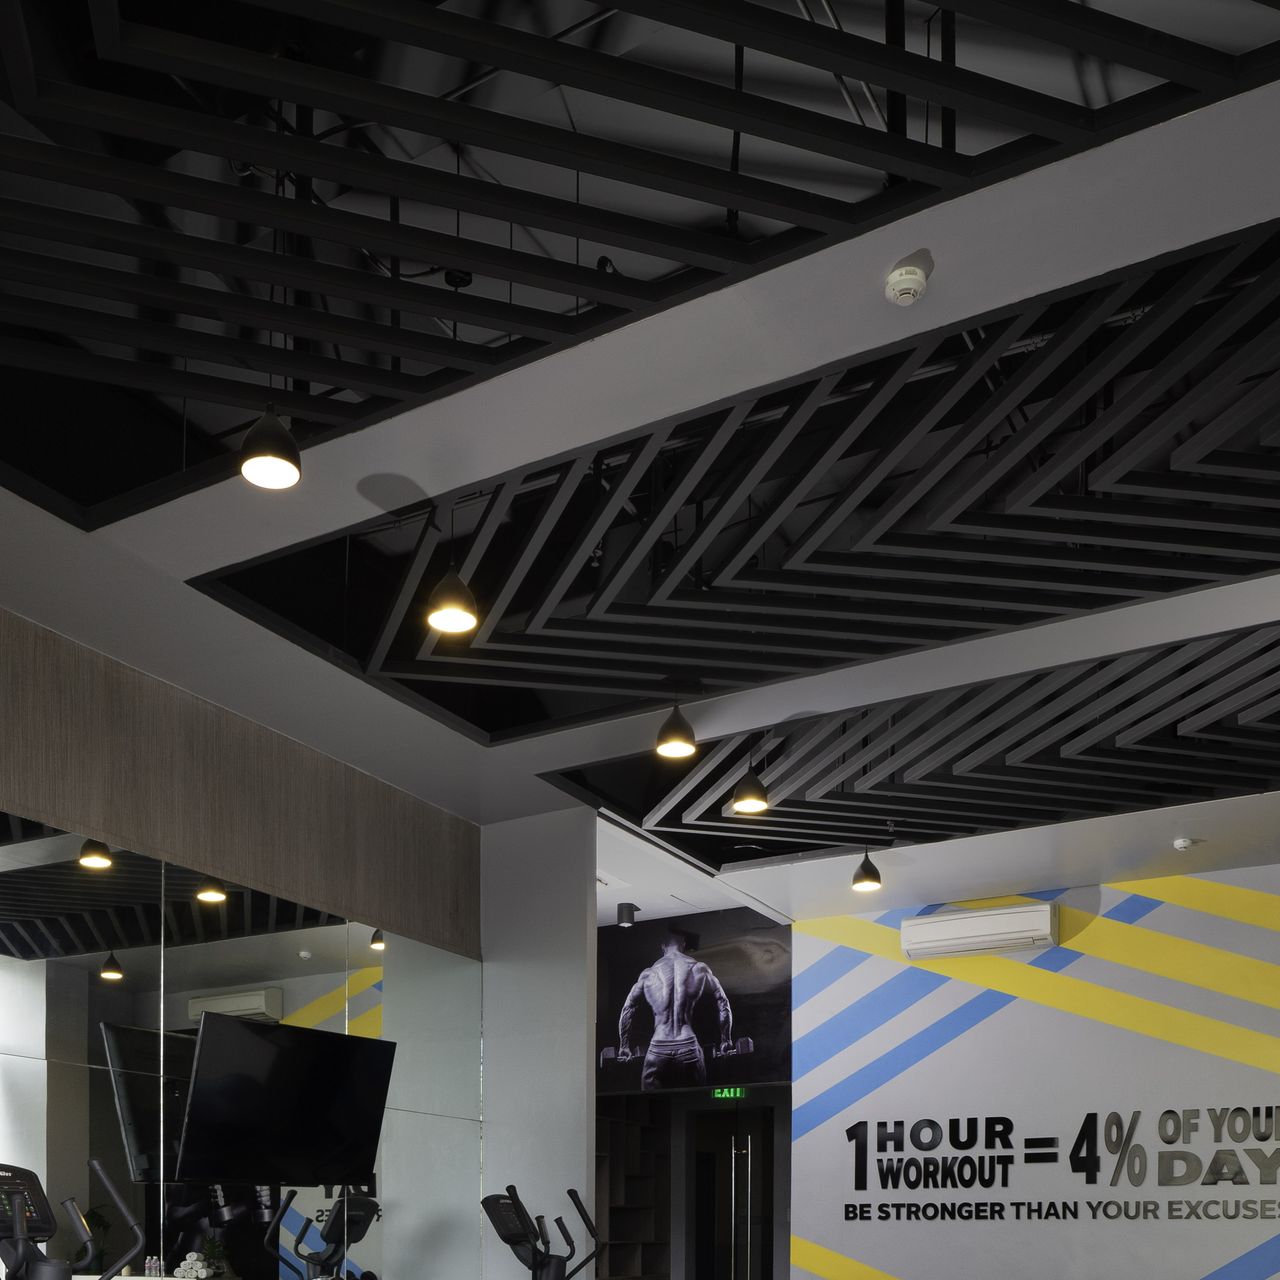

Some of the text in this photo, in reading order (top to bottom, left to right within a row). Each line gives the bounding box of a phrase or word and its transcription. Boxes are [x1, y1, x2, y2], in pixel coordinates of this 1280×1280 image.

[845, 1120, 868, 1191] 1
[876, 1117, 1014, 1152] HOUR
[1158, 1109, 1200, 1144] OF
[876, 1154, 1015, 1190] WORKOUT
[844, 1203, 872, 1221] BE
[877, 1202, 1005, 1221] STRONGER
[1010, 1201, 1079, 1220] THAN
[1086, 1200, 1160, 1220] YOUR
